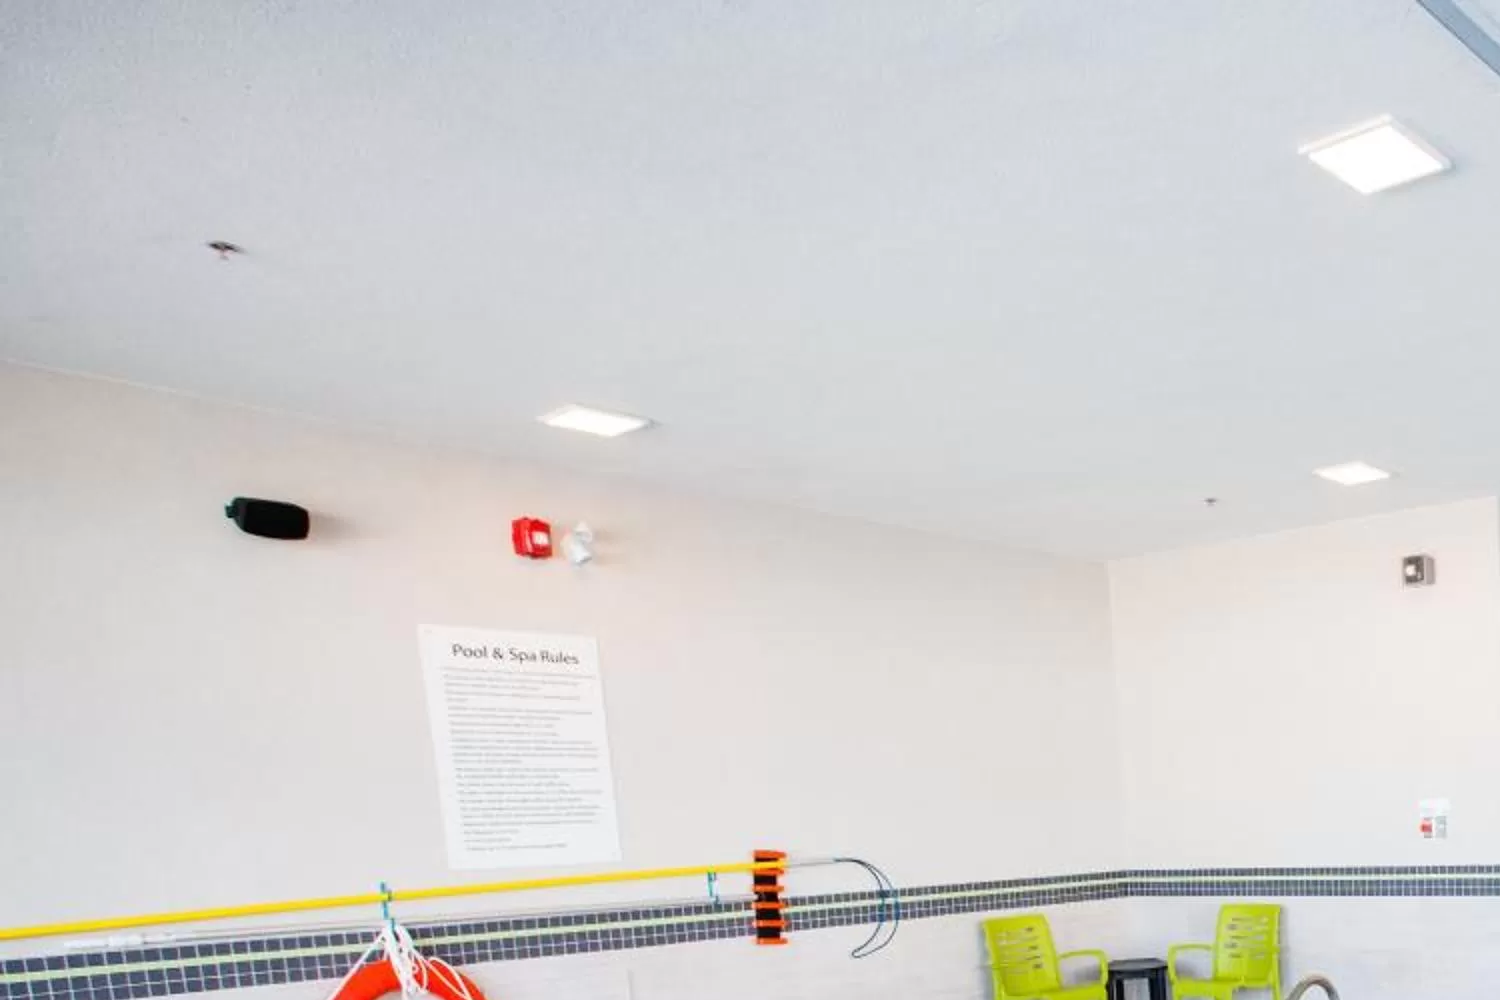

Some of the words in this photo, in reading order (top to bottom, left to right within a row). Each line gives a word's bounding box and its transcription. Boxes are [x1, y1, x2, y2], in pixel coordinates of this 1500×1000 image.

[452, 643, 488, 659] Pool
[492, 647, 503, 660] &
[508, 647, 537, 664] Spa
[540, 649, 580, 664] Rules
